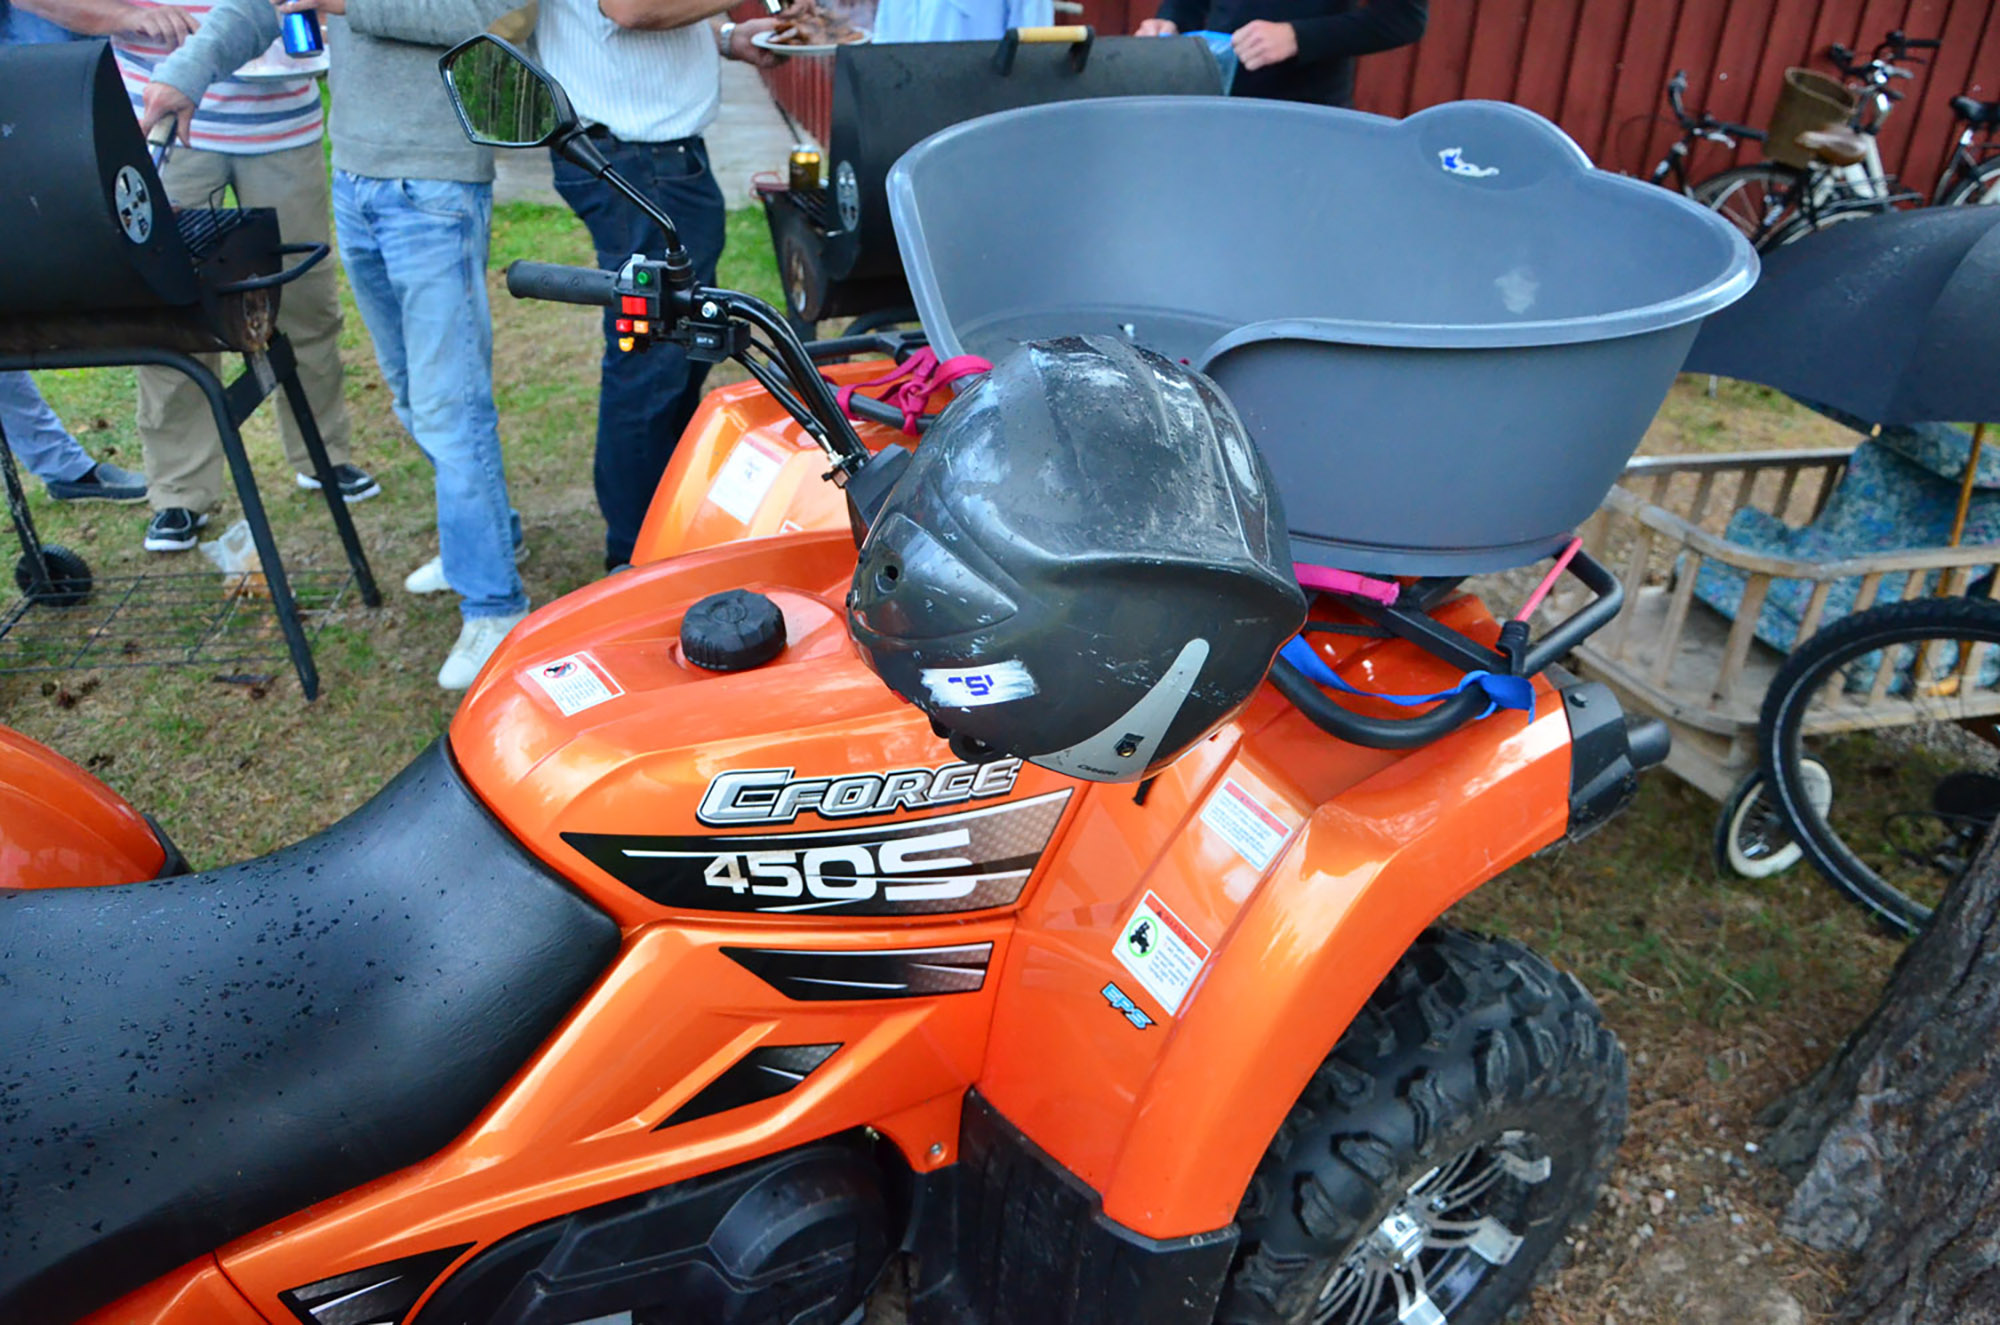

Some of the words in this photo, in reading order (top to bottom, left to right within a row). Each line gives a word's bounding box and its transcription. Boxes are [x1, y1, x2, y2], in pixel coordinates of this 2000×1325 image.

[697, 755, 1023, 826] CFORCE
[703, 828, 977, 902] 450S
[1101, 982, 1155, 1029] EPS
